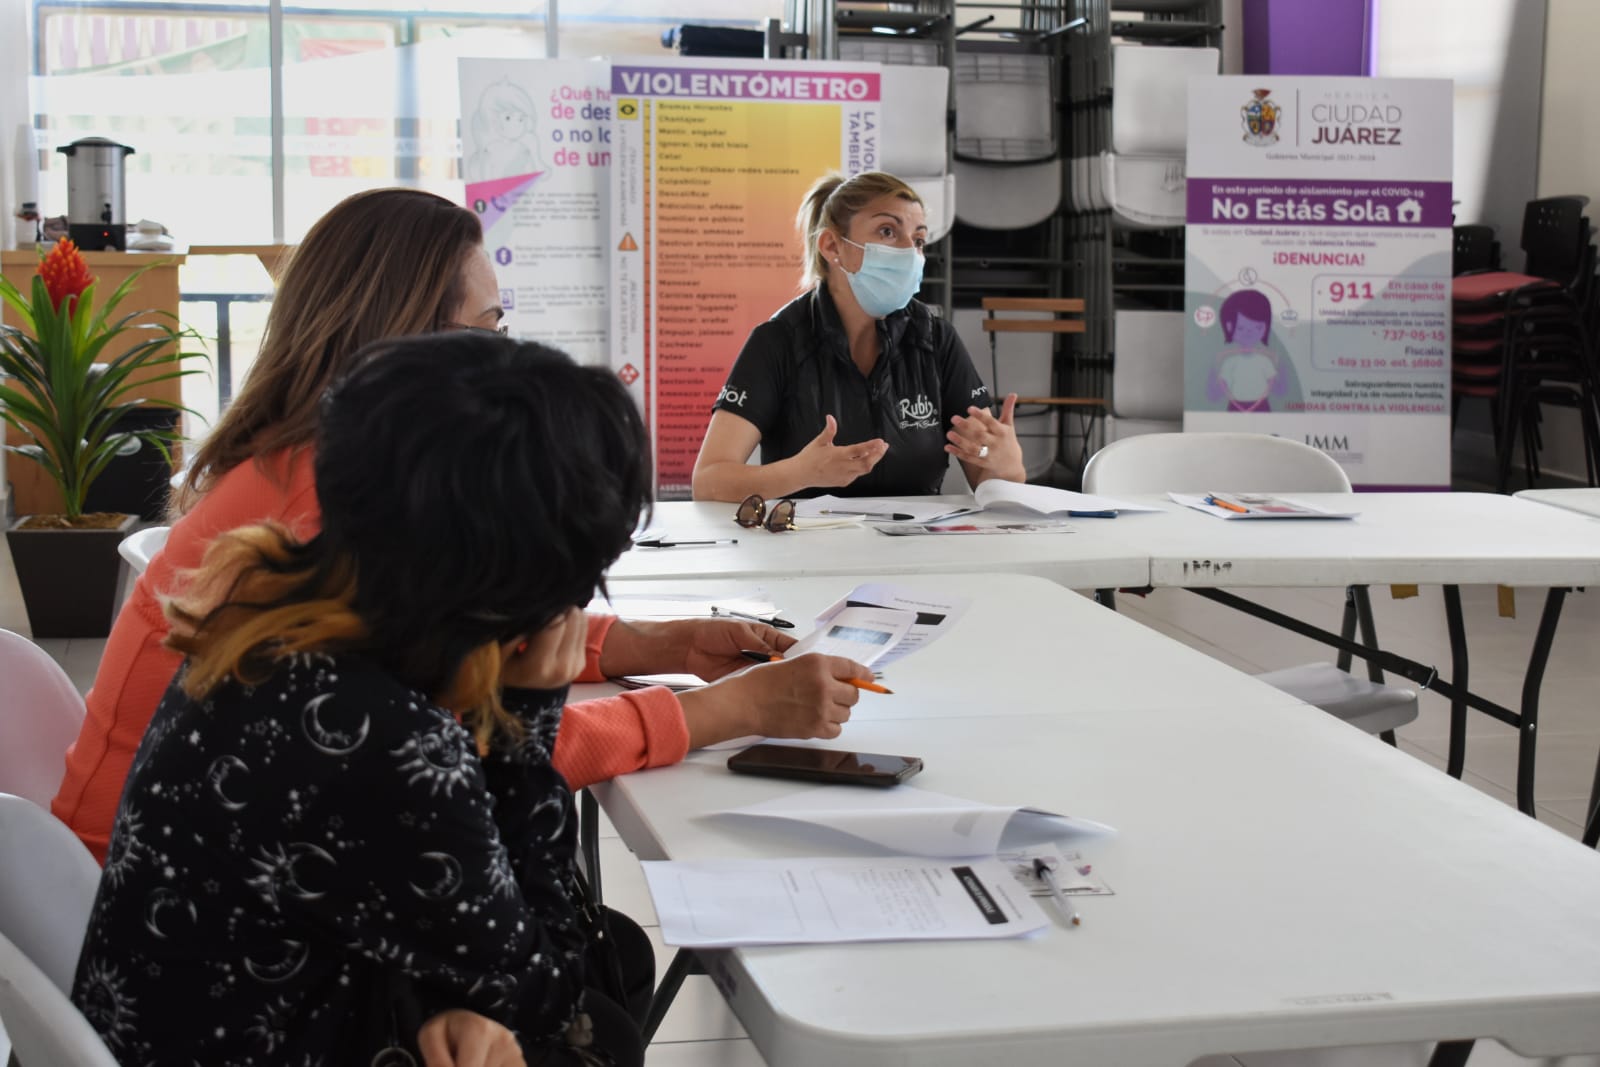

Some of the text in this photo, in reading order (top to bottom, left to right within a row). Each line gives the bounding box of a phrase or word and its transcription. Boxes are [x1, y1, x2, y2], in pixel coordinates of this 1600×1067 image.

[620, 71, 869, 99] VIOLENTÓMETRO
[550, 86, 592, 104] ¿Qué
[551, 103, 577, 121] de
[863, 111, 876, 131] LA
[1311, 104, 1403, 124] CIUDAD
[552, 129, 563, 142] o
[570, 129, 593, 143] no
[1311, 122, 1402, 145] JUÁREZ
[554, 149, 580, 167] de
[1211, 197, 1391, 222] No Estás Sola
[1273, 251, 1366, 268] ¡DENUNCIA!
[1329, 281, 1375, 303] 911
[1405, 281, 1430, 291] caso
[1432, 281, 1445, 291] de
